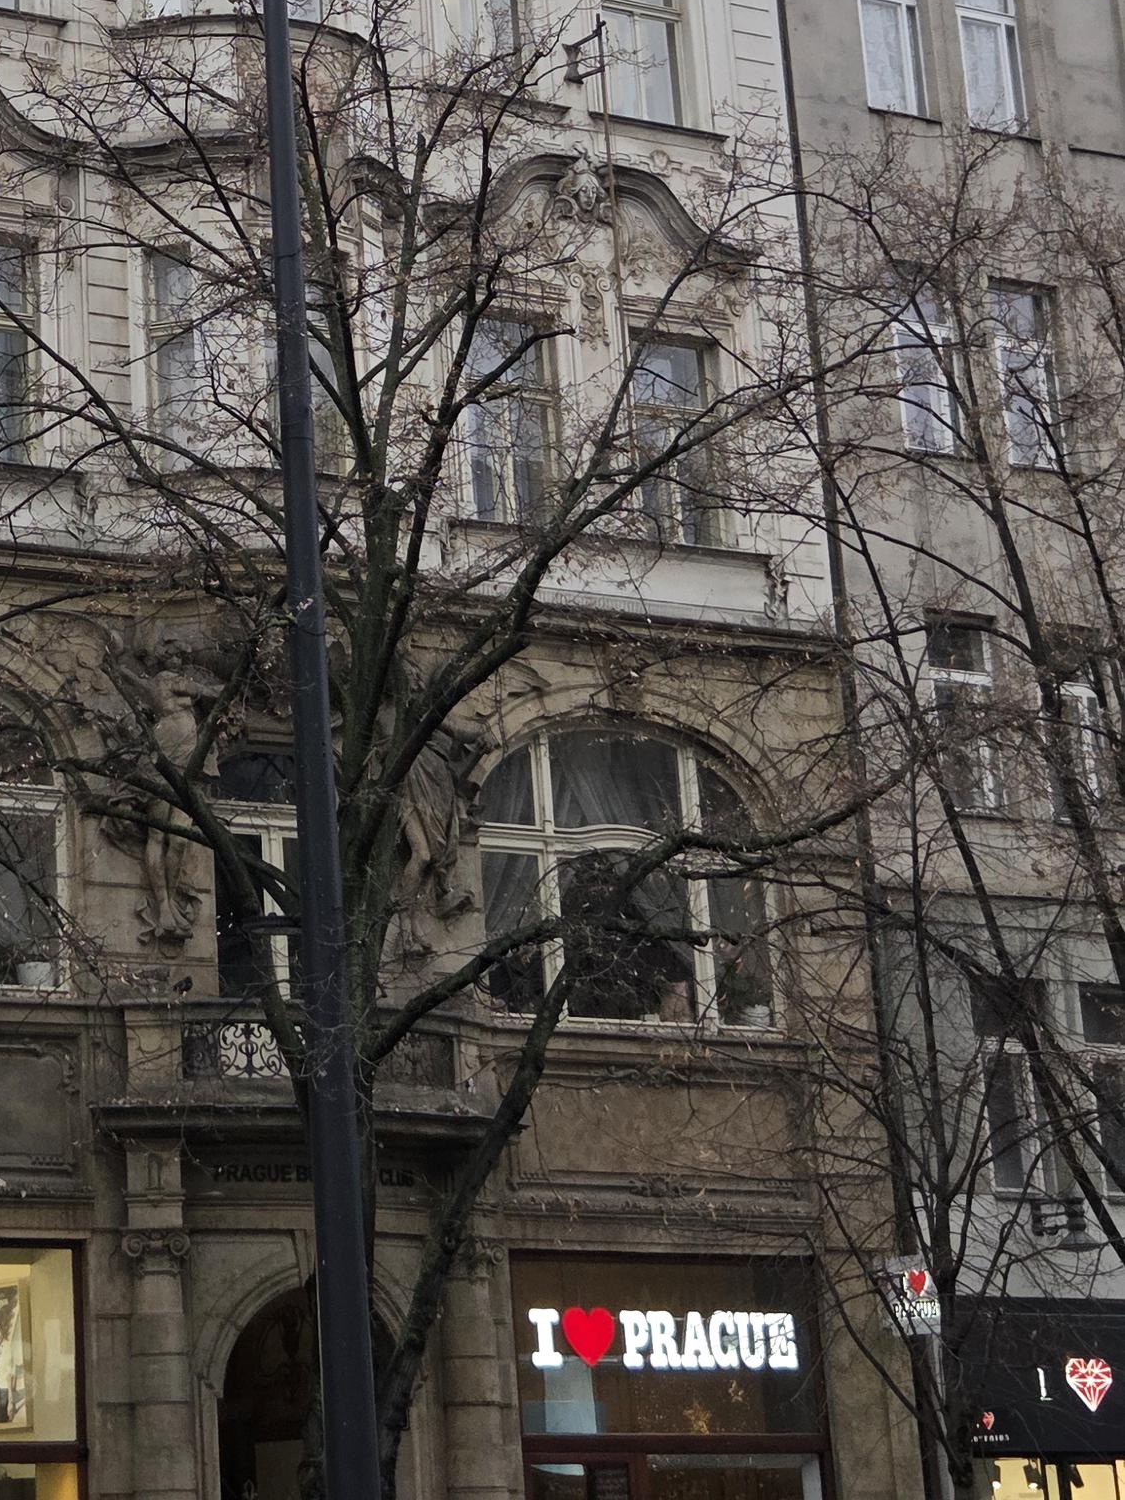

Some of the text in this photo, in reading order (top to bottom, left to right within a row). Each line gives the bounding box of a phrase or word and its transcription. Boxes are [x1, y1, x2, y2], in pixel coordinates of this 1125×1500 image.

[212, 1164, 293, 1183] PRAGUE
[528, 1308, 799, 1371] I PRAGUE
